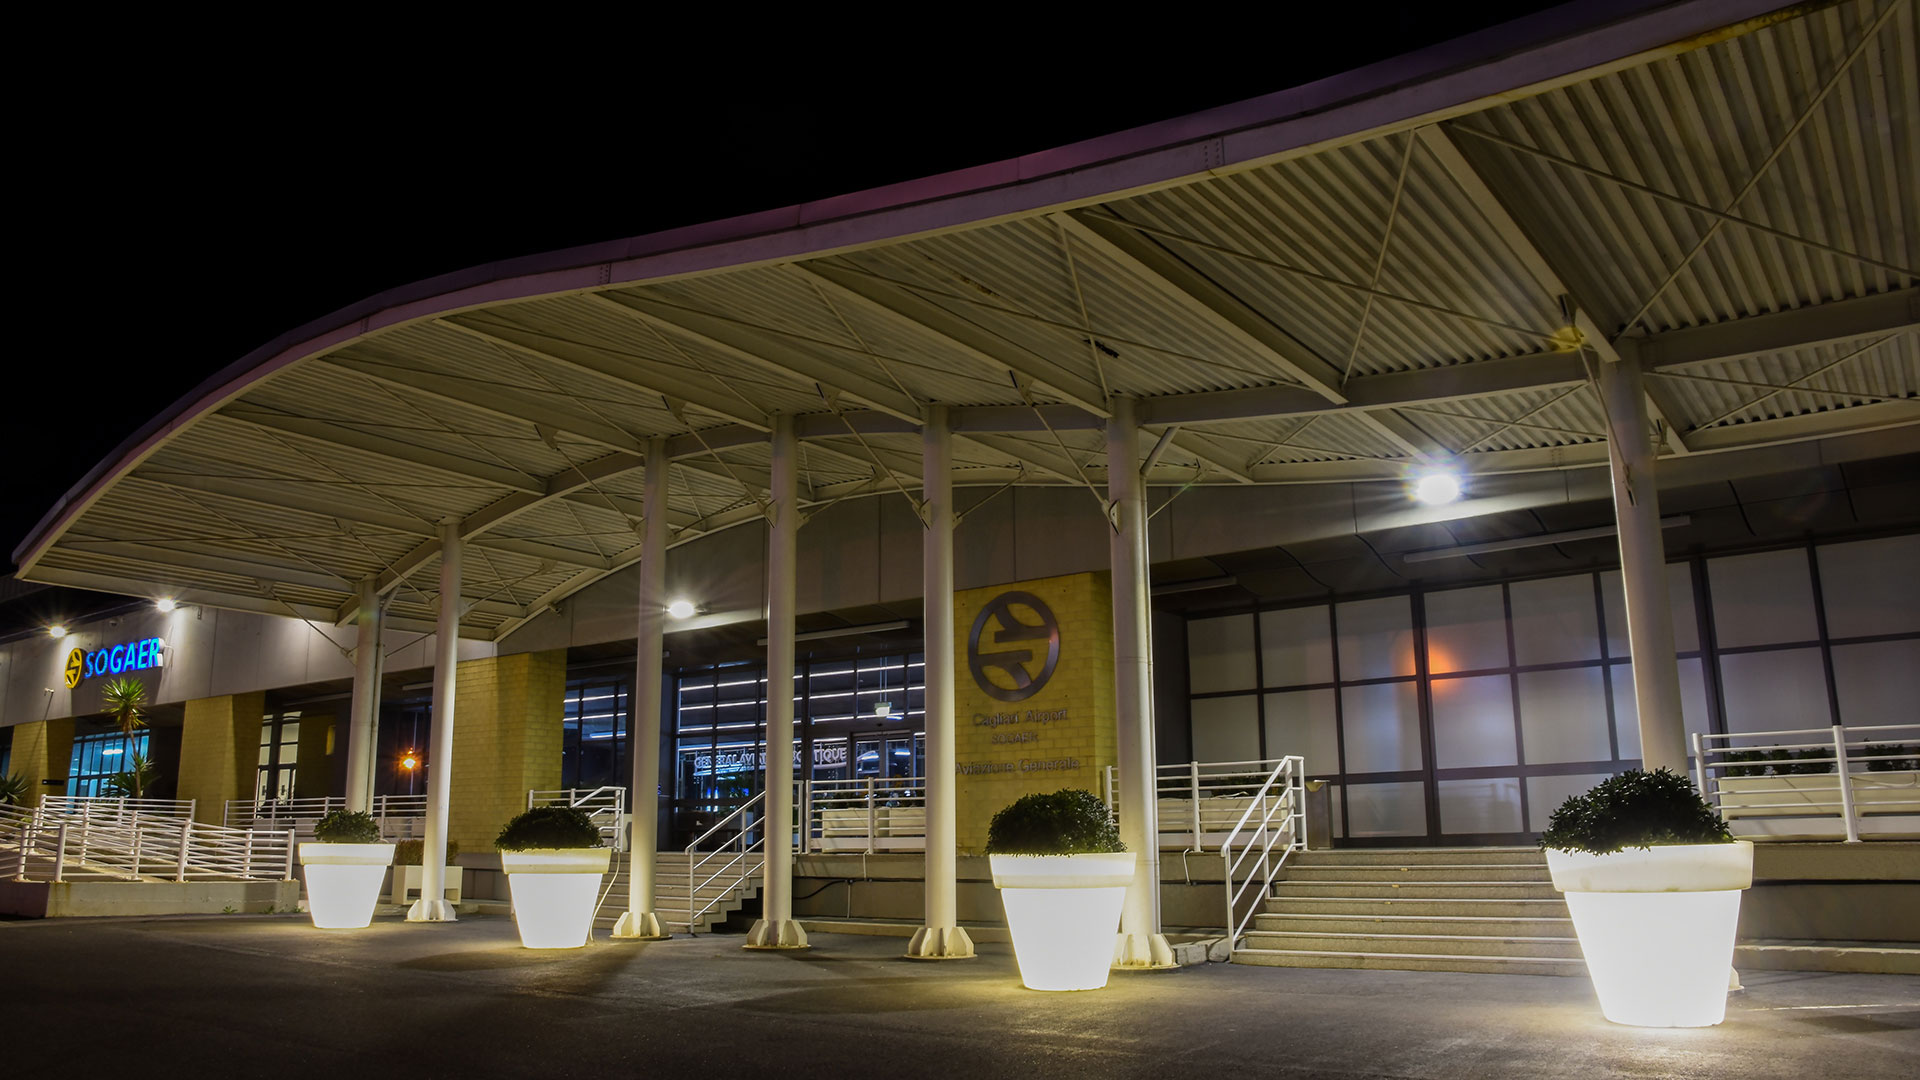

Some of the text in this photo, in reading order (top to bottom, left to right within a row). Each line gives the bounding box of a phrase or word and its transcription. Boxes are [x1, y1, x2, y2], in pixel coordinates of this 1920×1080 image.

[84, 637, 160, 678] SOGAER
[973, 709, 1068, 728] Cagliari Airport
[1018, 757, 1079, 773] Generale
